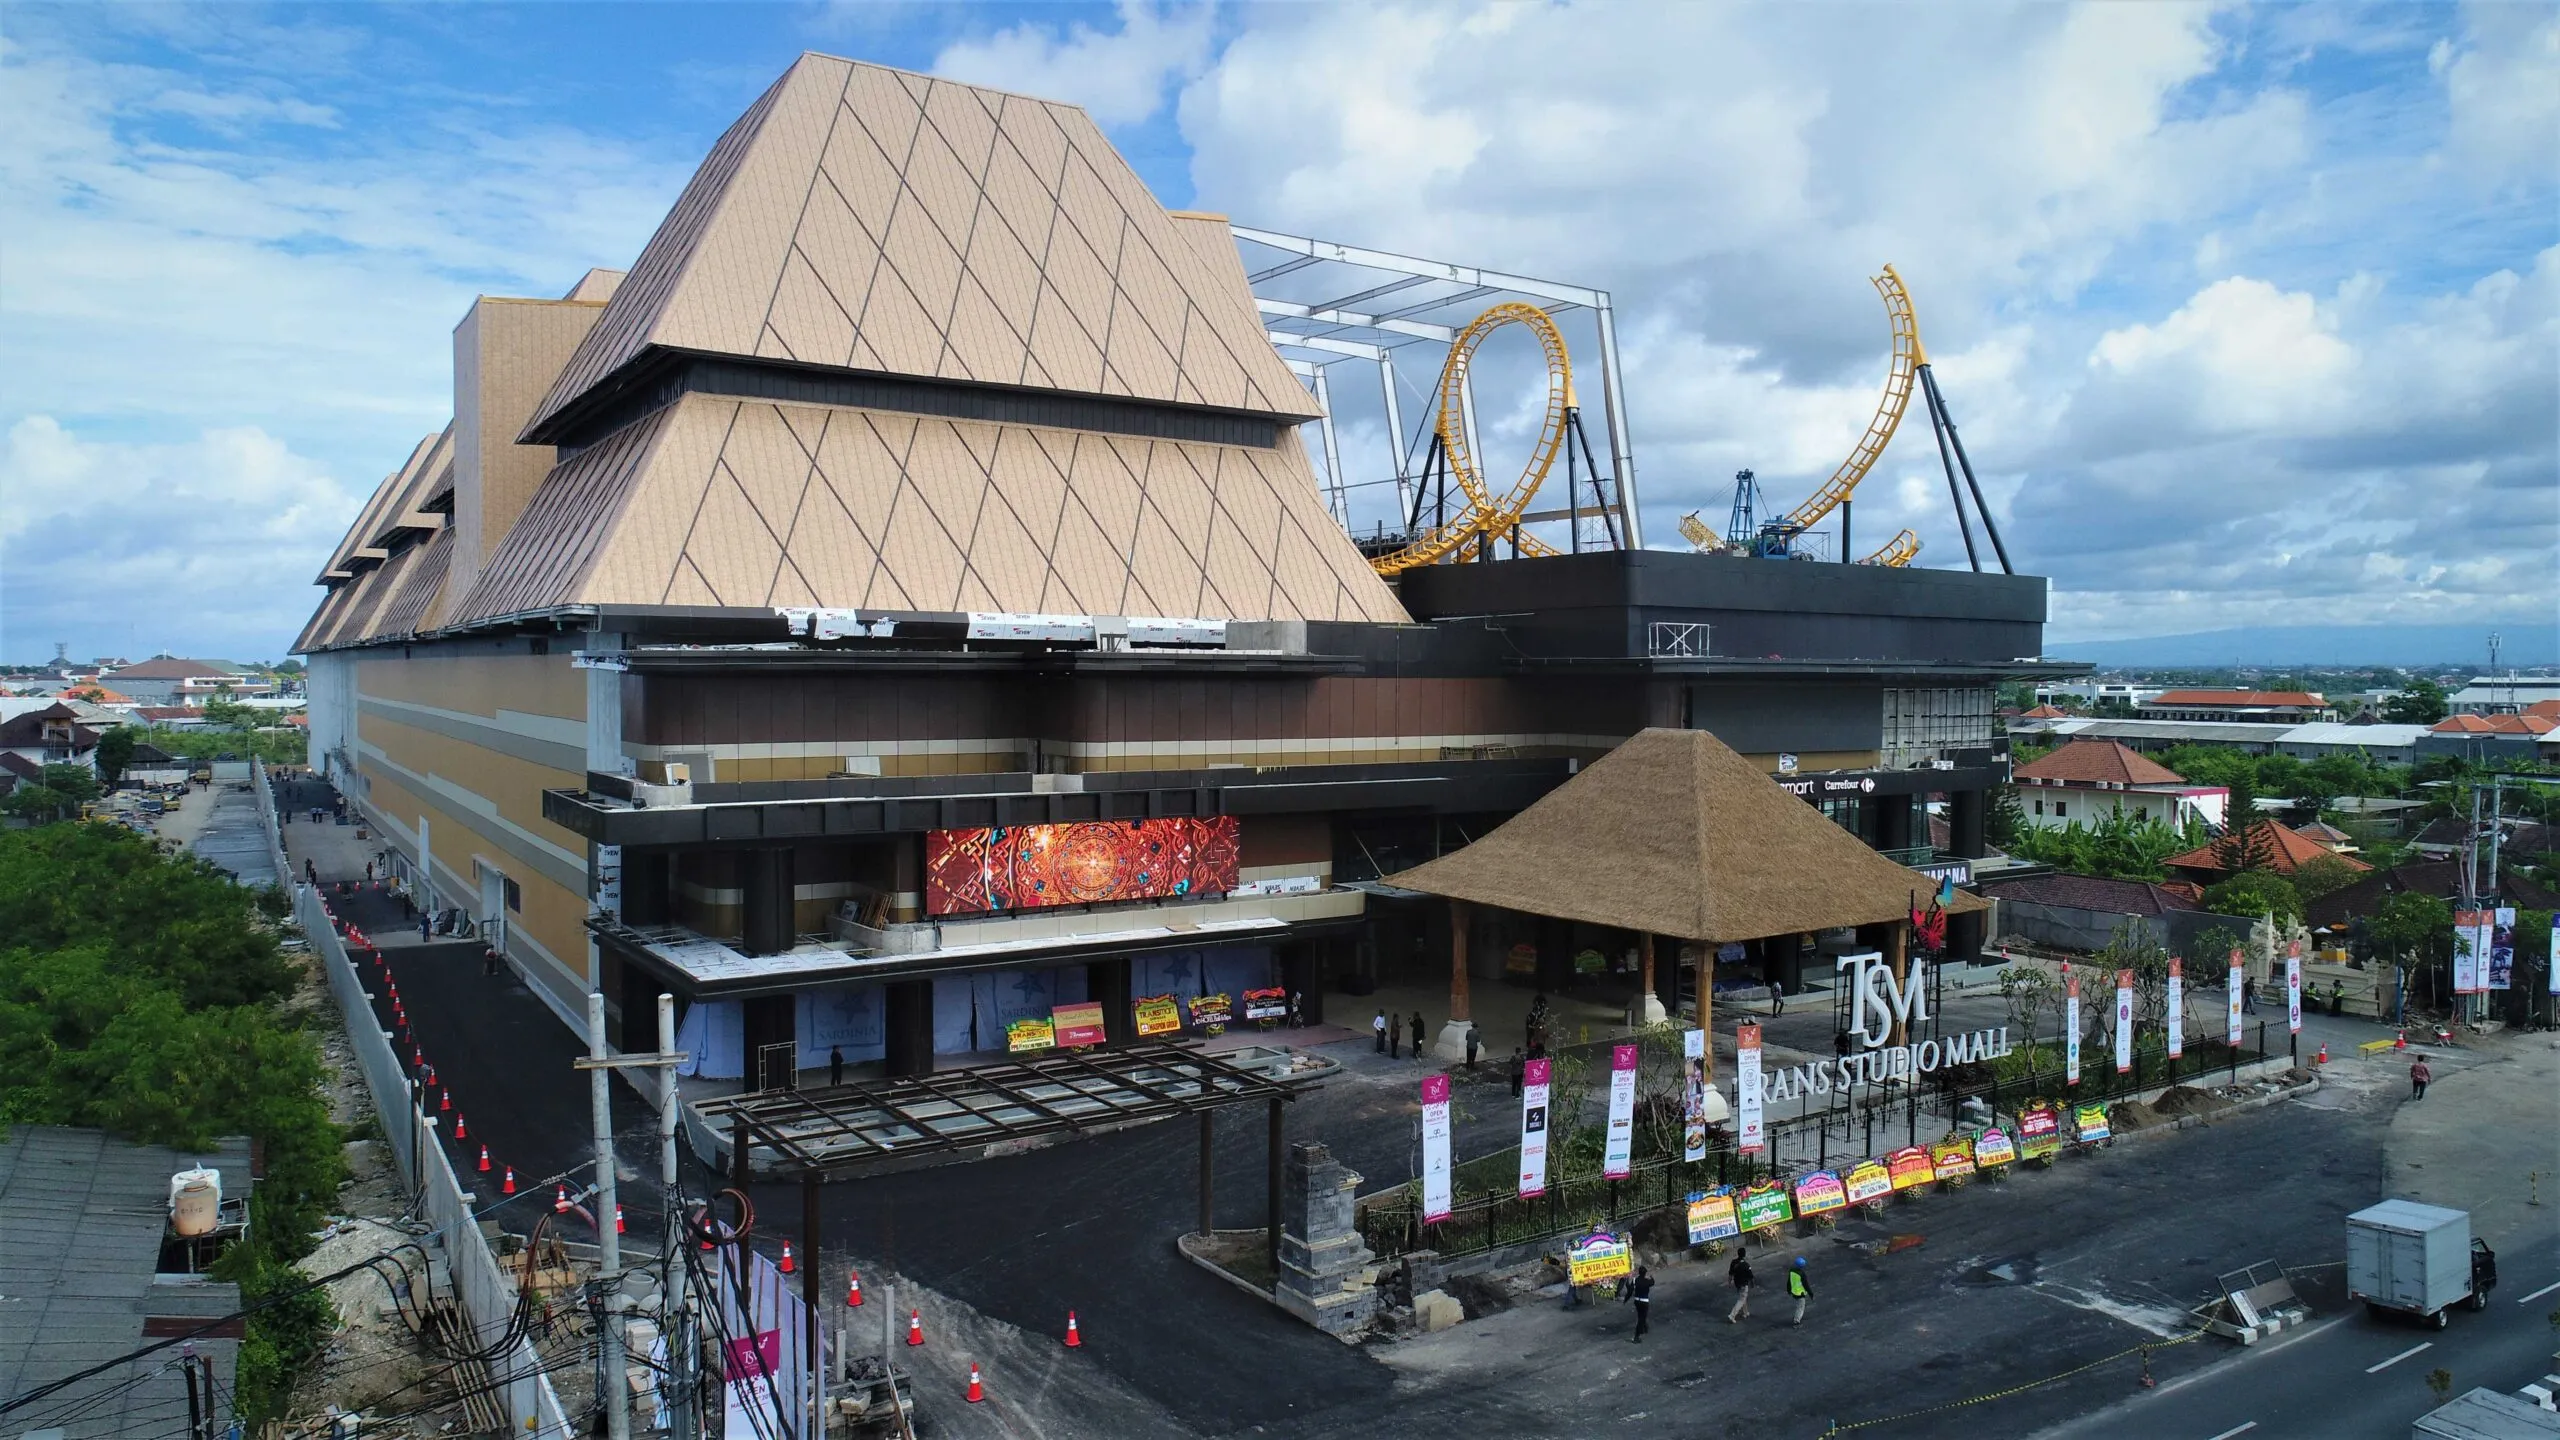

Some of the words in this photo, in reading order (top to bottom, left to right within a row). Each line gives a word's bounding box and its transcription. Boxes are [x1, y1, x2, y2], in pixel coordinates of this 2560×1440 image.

[1825, 780, 1859, 791] Carrefour
[1837, 952, 1931, 1047] TSM
[1732, 1061, 1830, 1104] RANS
[1836, 1040, 1940, 1090] STUDIO
[1944, 1027, 2012, 1068] MALL
[1801, 1190, 1820, 1200] ASIAN
[1820, 1185, 1840, 1194] FUSION
